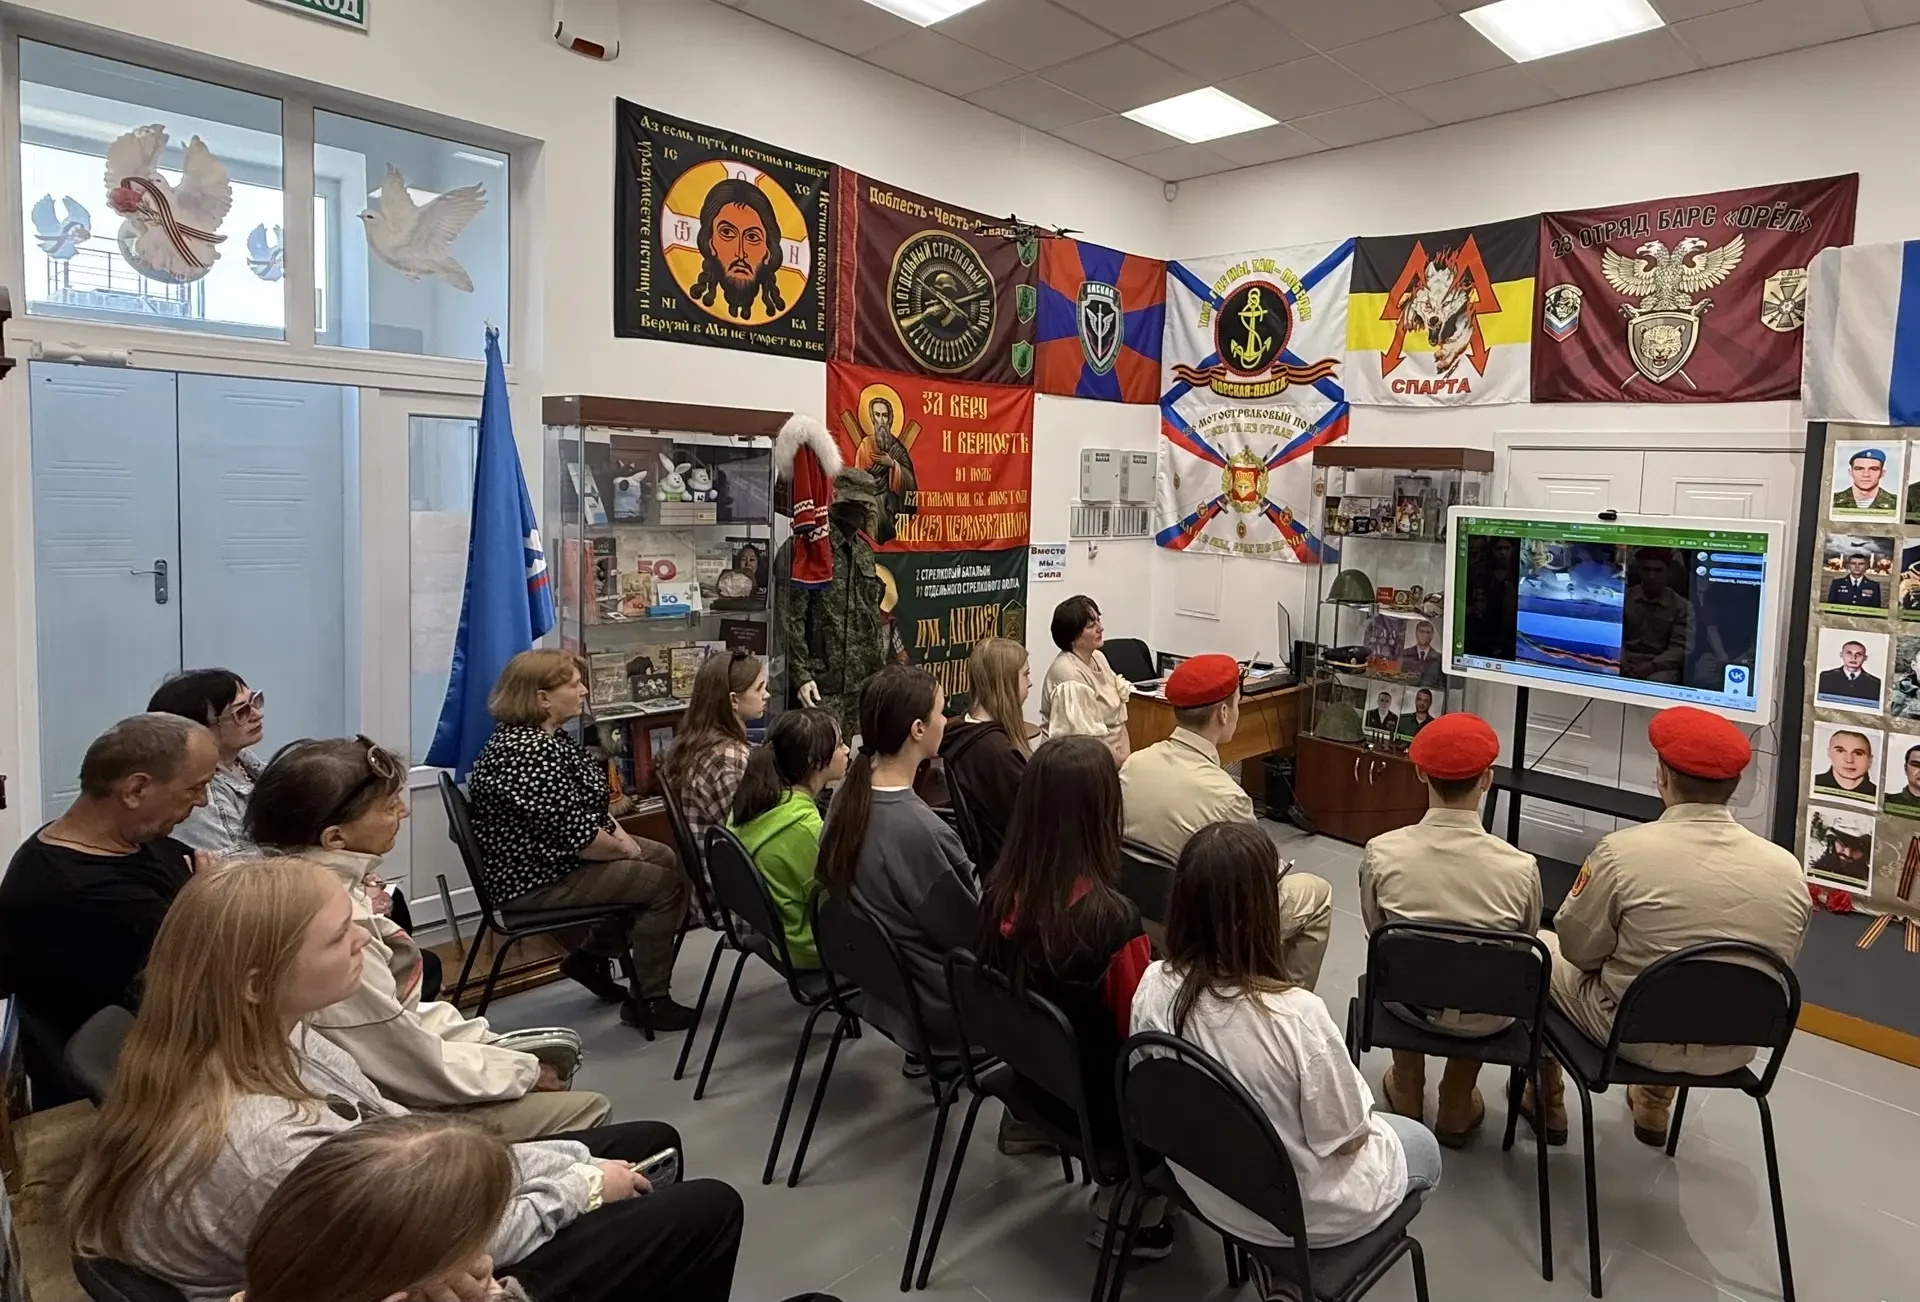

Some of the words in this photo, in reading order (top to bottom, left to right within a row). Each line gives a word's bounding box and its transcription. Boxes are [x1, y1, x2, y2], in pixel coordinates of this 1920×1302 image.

[640, 115, 659, 133] Аз
[663, 124, 693, 142] есмь
[698, 134, 727, 151] путь
[741, 147, 783, 168] истина
[795, 160, 830, 179] живот
[818, 189, 830, 242] Истина
[1579, 212, 1650, 249] ОТРЯД
[1657, 205, 1717, 231] БАРС
[1723, 202, 1812, 233] «ОРЁЛ»
[636, 239, 651, 295] истину
[896, 241, 932, 300] ОТДЕЛЬНЫЙ
[932, 242, 988, 289] СТРЕЛКОВЫЙ
[896, 303, 911, 316] 91
[977, 300, 990, 329] ПОЛК
[817, 312, 825, 331] вы
[640, 314, 689, 334] Веруяй
[705, 322, 728, 337] Мя
[731, 327, 746, 340] не
[749, 332, 787, 347] умрет
[789, 338, 802, 349] во
[805, 341, 824, 352] век
[1211, 380, 1250, 397] МОРСКАЯ
[1253, 376, 1287, 396] ПЕХОТА
[1391, 377, 1472, 395] СПАРТА
[922, 391, 943, 416] ЗА
[950, 393, 988, 420] ВЕРУ
[1198, 408, 1291, 429] МОТОСТРЕЛКОВЫЙ
[942, 430, 952, 453] И
[957, 431, 1029, 455] ВЕРНОСТЬ
[1031, 547, 1066, 555] Вместе
[637, 559, 677, 581] 50
[921, 565, 961, 580] СТРЕЛКОВЫЙ
[962, 565, 991, 578] БАТАЛЬОН
[1039, 559, 1054, 567] мы
[1038, 571, 1061, 579] сила
[661, 595, 678, 603] 50
[924, 583, 961, 598] ОТДЕЛЬНОГО
[1730, 671, 1743, 680] VK
